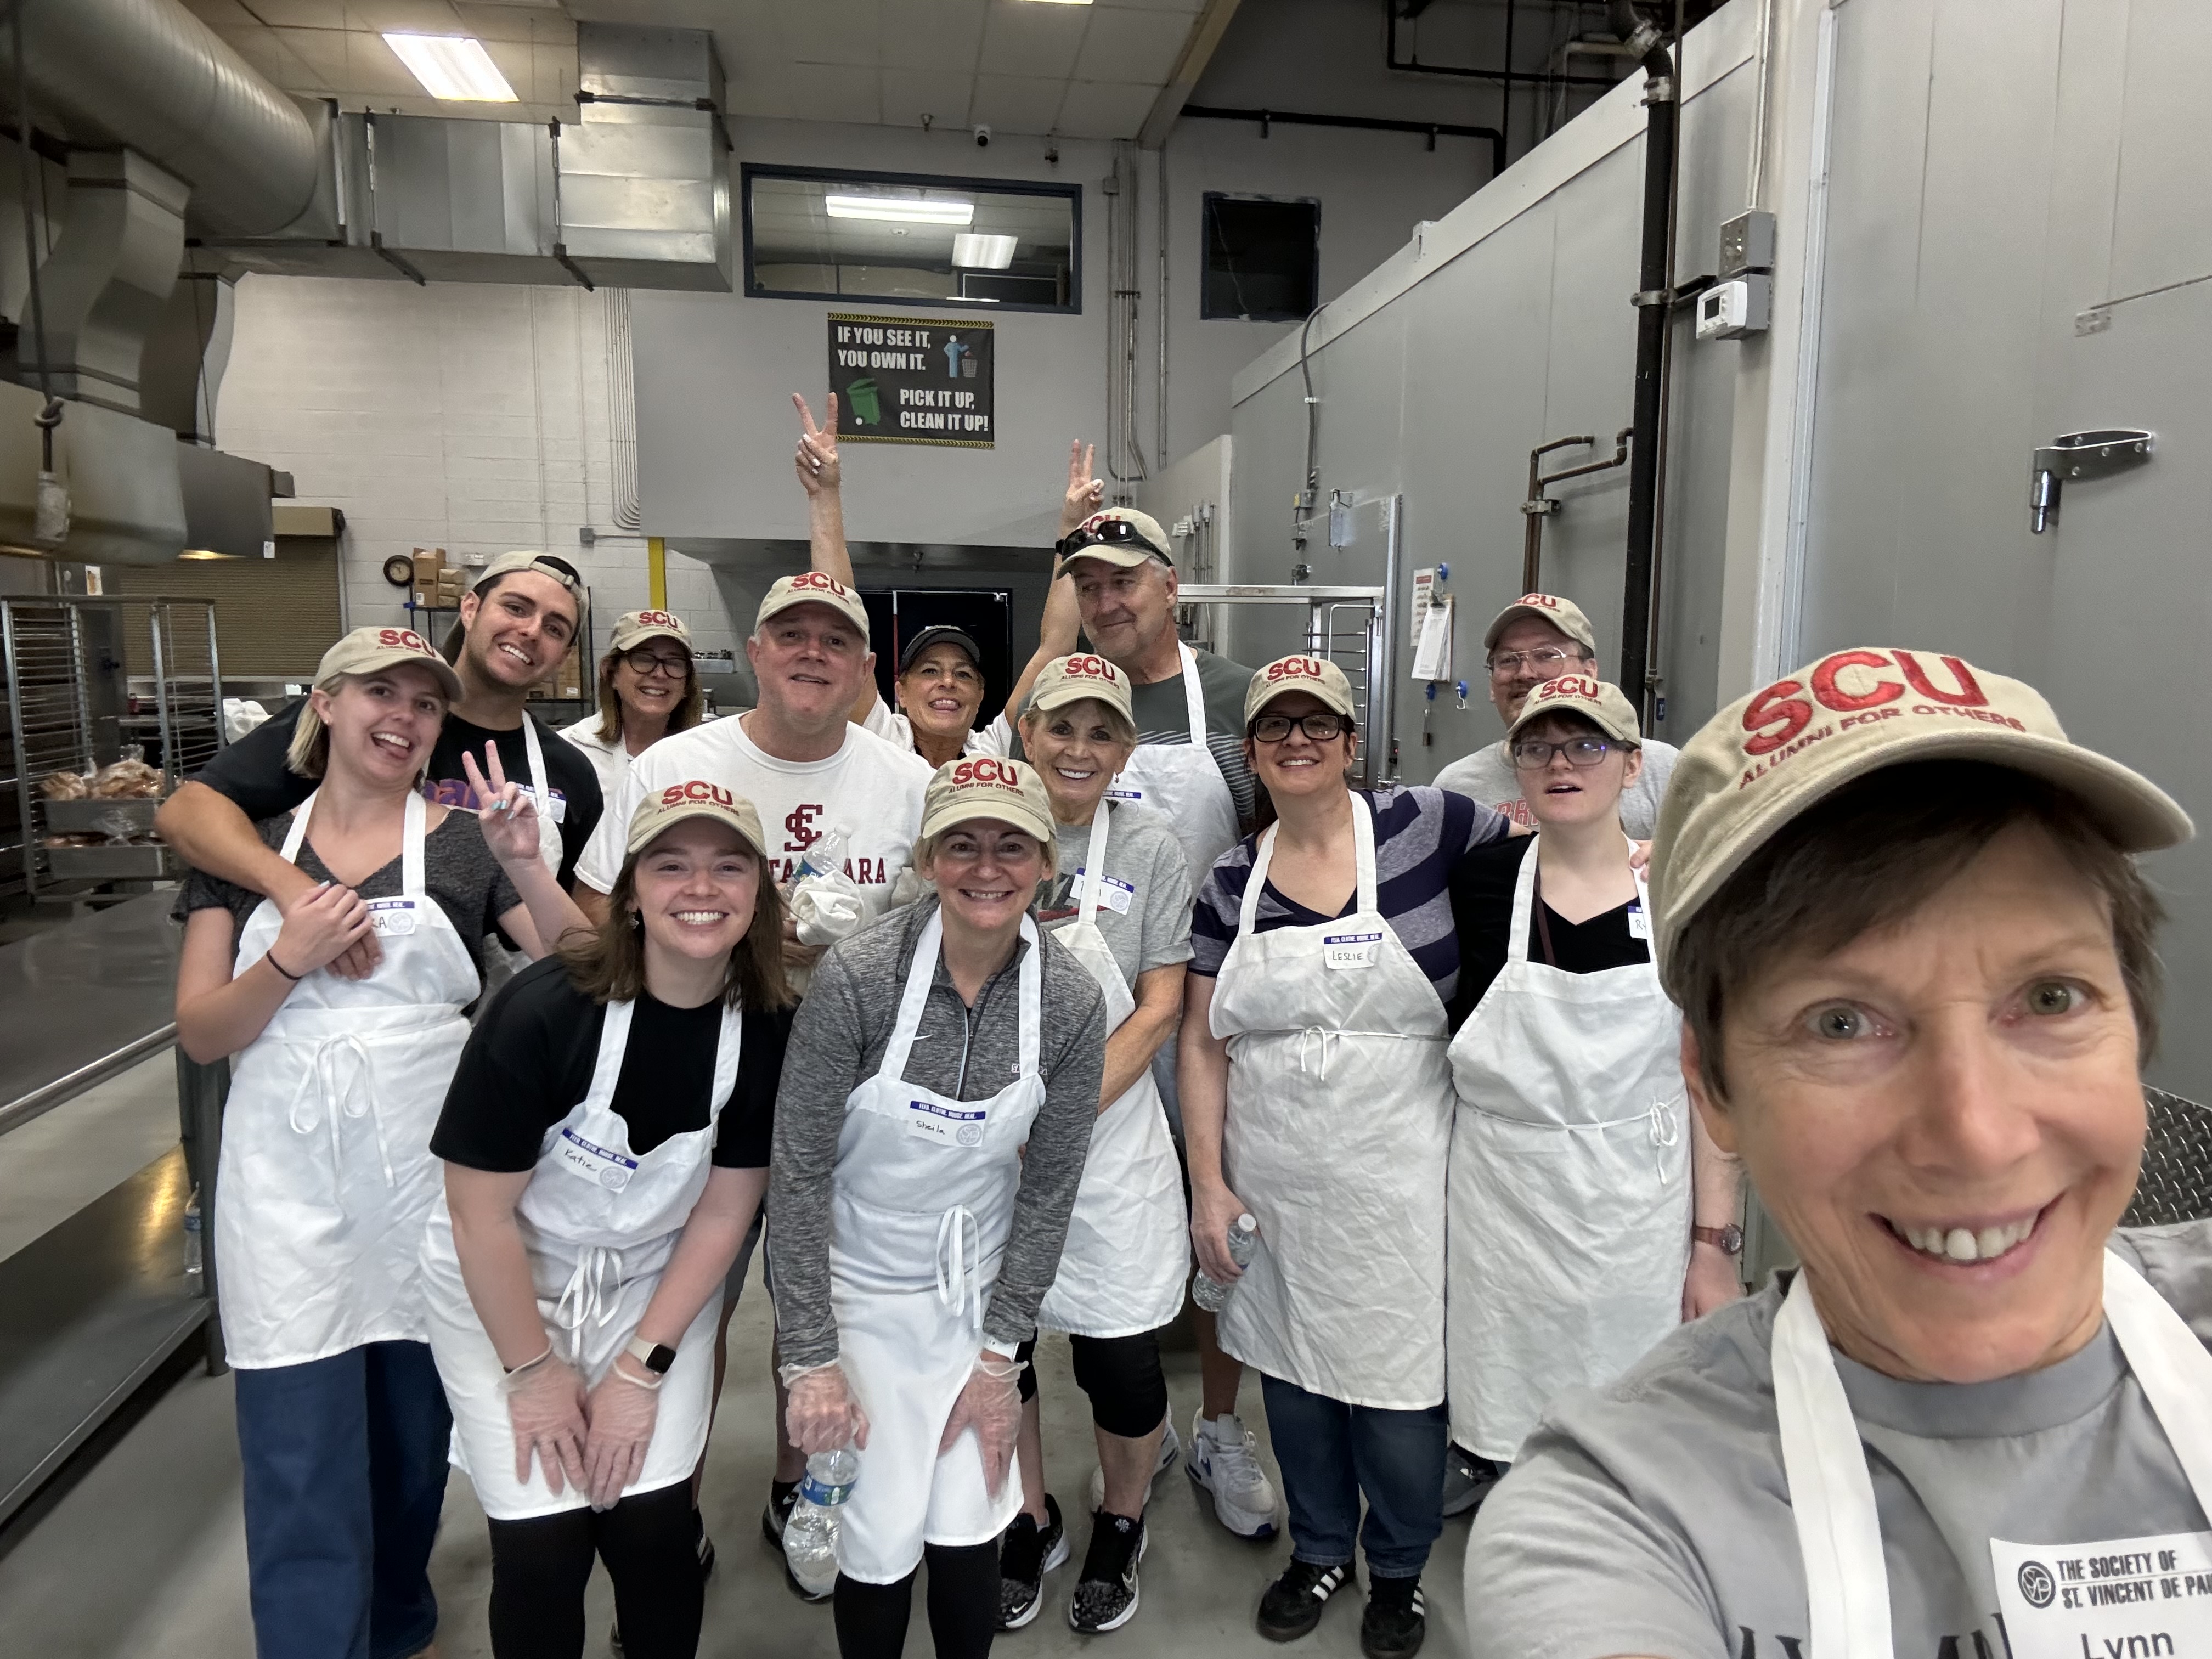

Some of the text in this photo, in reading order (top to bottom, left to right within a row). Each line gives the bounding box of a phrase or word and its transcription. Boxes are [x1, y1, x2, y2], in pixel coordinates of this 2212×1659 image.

[838, 326, 931, 349] IF YOU SEE IT,
[838, 349, 926, 370] YOU OWN IT.
[900, 388, 975, 410] PICK IT UP,
[900, 411, 988, 431] CLEAN IT UP!
[791, 573, 845, 596] SCU
[639, 612, 678, 628] SCU
[1065, 656, 1115, 681] SCU
[1267, 658, 1321, 681] SCU
[1539, 677, 1598, 698] SCU
[1742, 650, 1989, 755] SCU
[1739, 704, 2026, 790] ALUMNI FOR OTHERS
[952, 759, 1018, 786] SCU
[661, 781, 733, 805] SCU
[949, 782, 974, 794] ALUMNI
[995, 783, 1024, 797] OTHERS
[658, 800, 686, 815] ALUMNI
[709, 801, 740, 816] OTHERS
[1333, 950, 1364, 960] LESLIE
[916, 1120, 945, 1135] Sheila
[565, 1149, 597, 1171] Katie
[2056, 1550, 2176, 1581] THE SOCIETY OF
[2061, 1587, 2083, 1609] ST.
[2087, 1579, 2154, 1606] VINCENT
[2160, 1577, 2182, 1599] DE
[2081, 1632, 2175, 1659] Lynn
